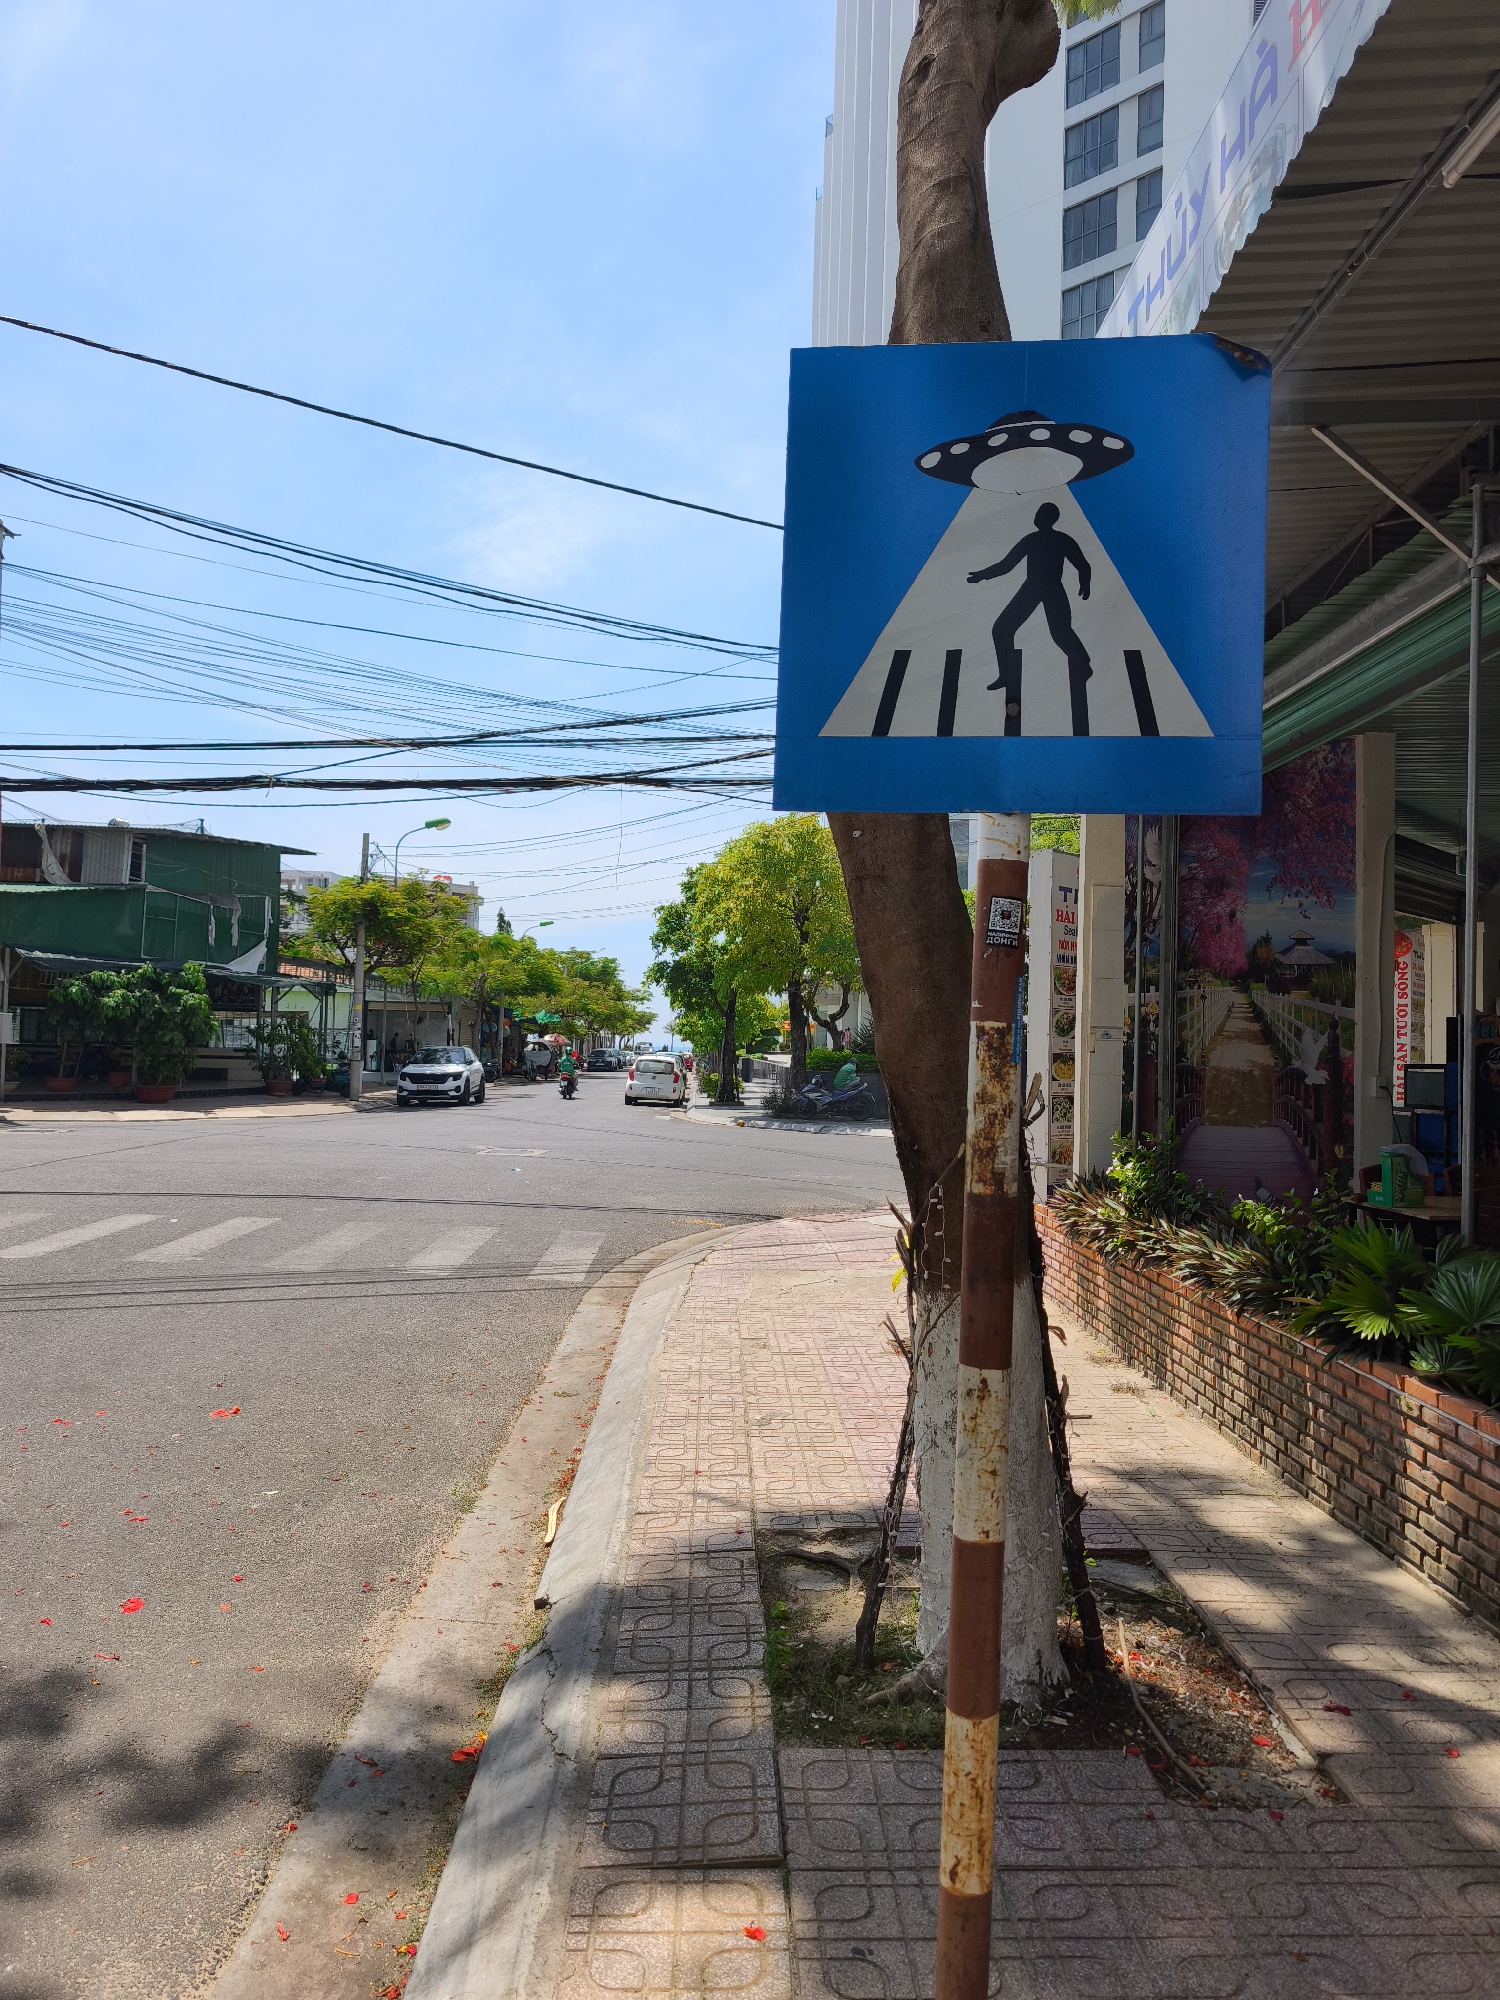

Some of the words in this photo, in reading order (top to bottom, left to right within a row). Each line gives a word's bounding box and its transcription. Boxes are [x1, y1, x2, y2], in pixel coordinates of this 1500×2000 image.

[1220, 36, 1278, 195] HÀ
[1056, 905, 1075, 925] HẢI
[986, 936, 1018, 947] ДОНГИ
[1396, 1002, 1409, 1039] TƯƠI
[1393, 1043, 1408, 1072] SẢN
